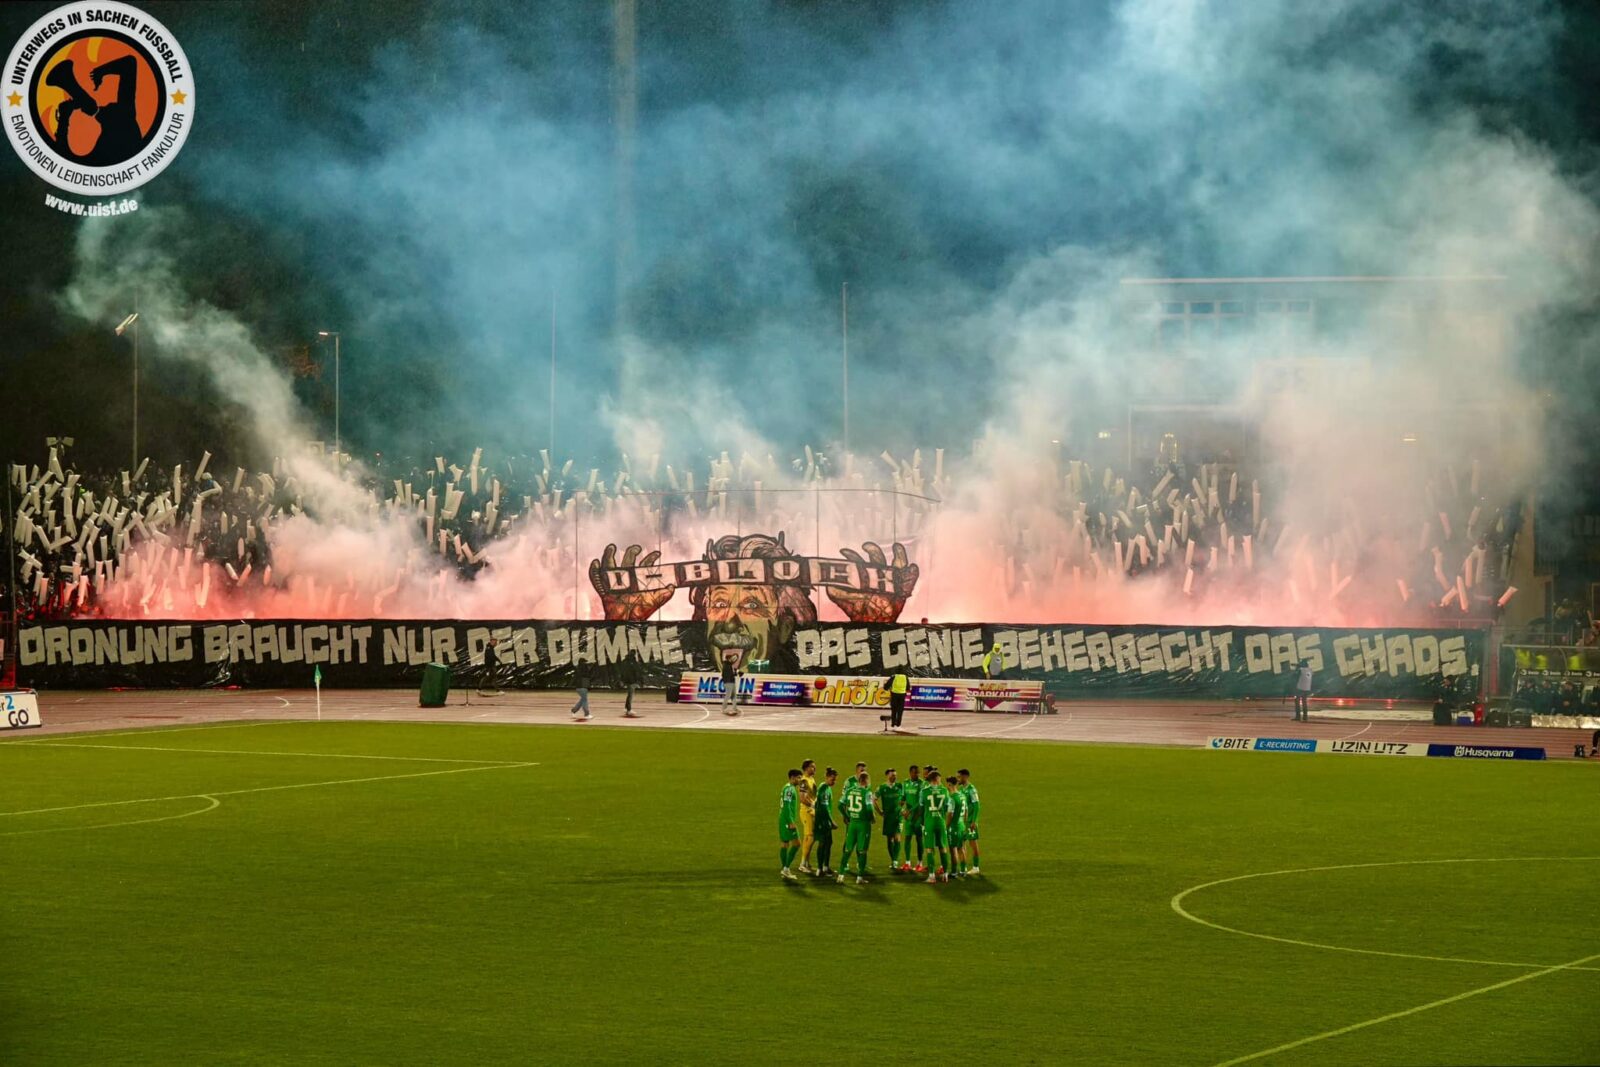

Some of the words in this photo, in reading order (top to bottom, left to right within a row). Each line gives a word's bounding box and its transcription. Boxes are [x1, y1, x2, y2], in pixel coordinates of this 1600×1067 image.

[18, 625, 193, 666] ORDNUNG
[203, 624, 372, 665] BRAUCHT
[383, 625, 458, 666] NUR
[466, 626, 540, 667] DER
[796, 627, 871, 670] DAS
[880, 628, 985, 669] GENIE
[993, 629, 1233, 674] BEHERRSCHT
[1244, 633, 1324, 674] DAS
[812, 677, 892, 705] inhofe
[8, 709, 29, 728] GO
[1223, 738, 1250, 749] BITE
[1259, 741, 1311, 750] E-RECRUITING
[1464, 747, 1515, 758] Husqvarna
[847, 794, 863, 812] 15
[927, 794, 945, 811] 17
